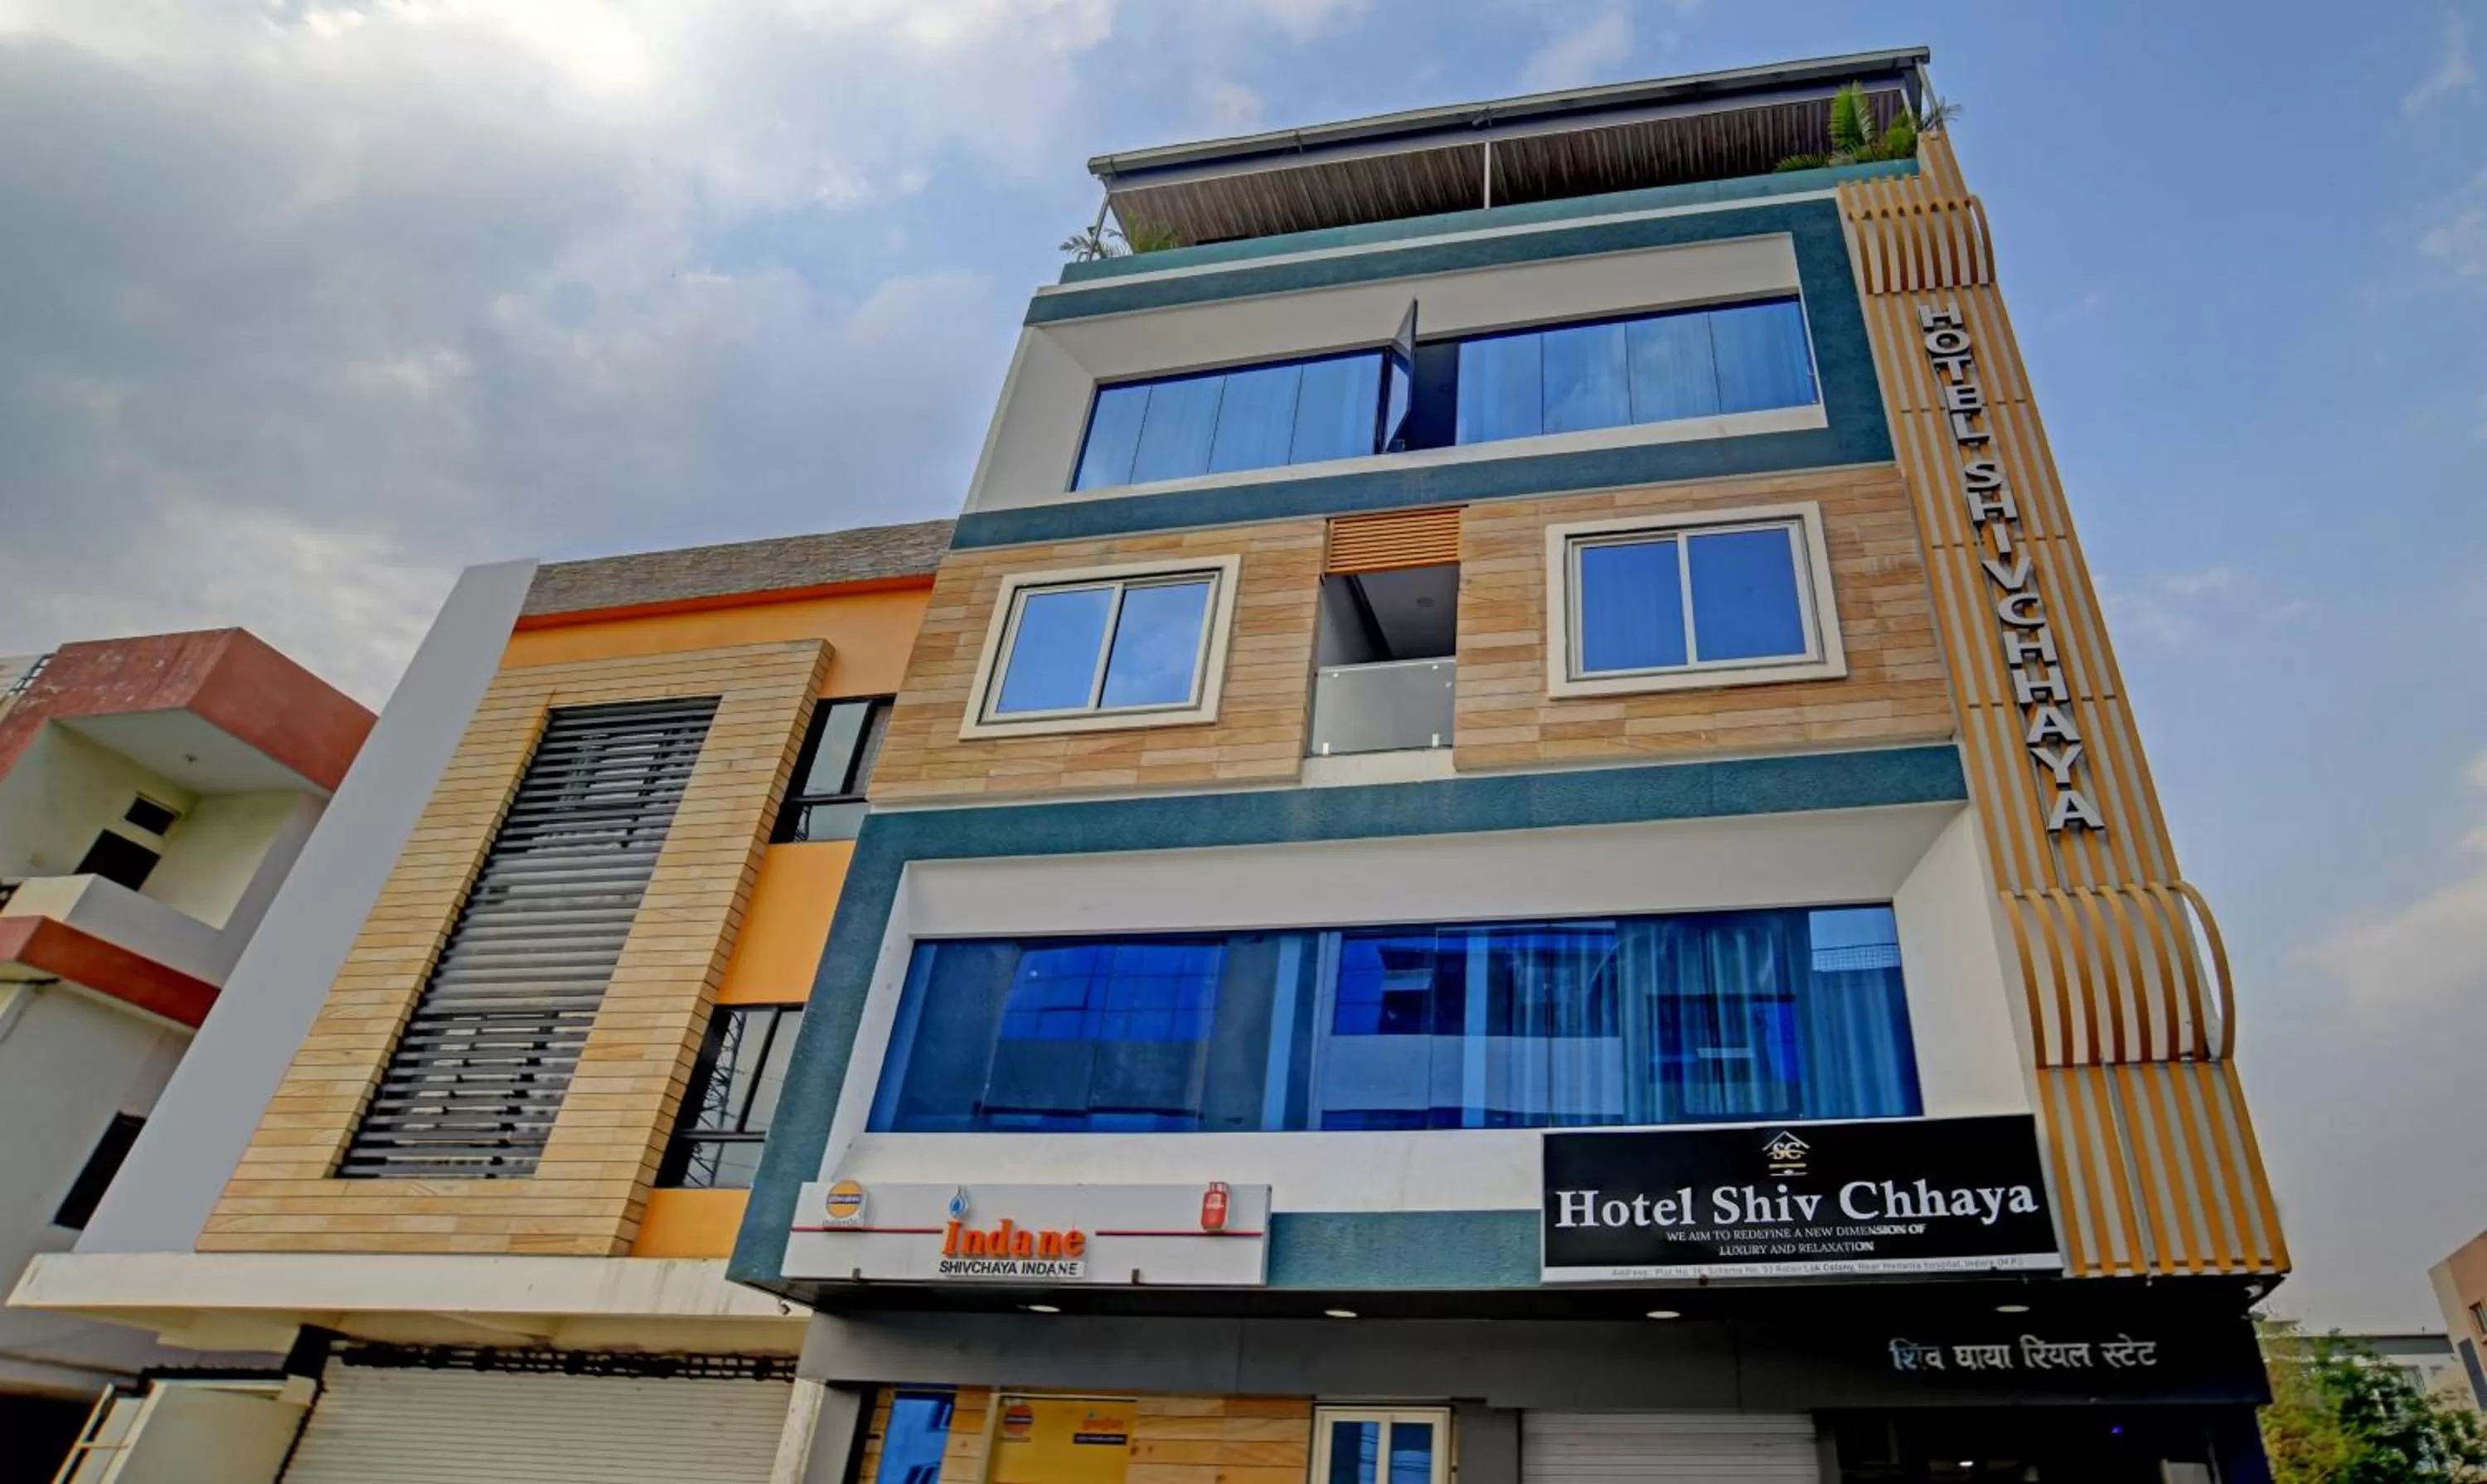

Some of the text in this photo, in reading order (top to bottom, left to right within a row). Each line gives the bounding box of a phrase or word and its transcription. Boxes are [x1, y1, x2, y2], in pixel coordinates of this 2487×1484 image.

[1918, 303, 1990, 444] HOTEL
[1555, 1178, 2039, 1228] Hotel Shiv Chhaya
[941, 1218, 1087, 1258] Indane
[1666, 1223, 1927, 1242] WE AIM TO REDEFINE A NEW DIMENSION OF
[1719, 1241, 1875, 1256] LUXURY AND RELAXATION
[939, 1259, 1079, 1276] SHIVCHAYA INDANE
[2019, 1334, 2094, 1370] रियल
[2100, 1333, 2157, 1370] स्टेट
